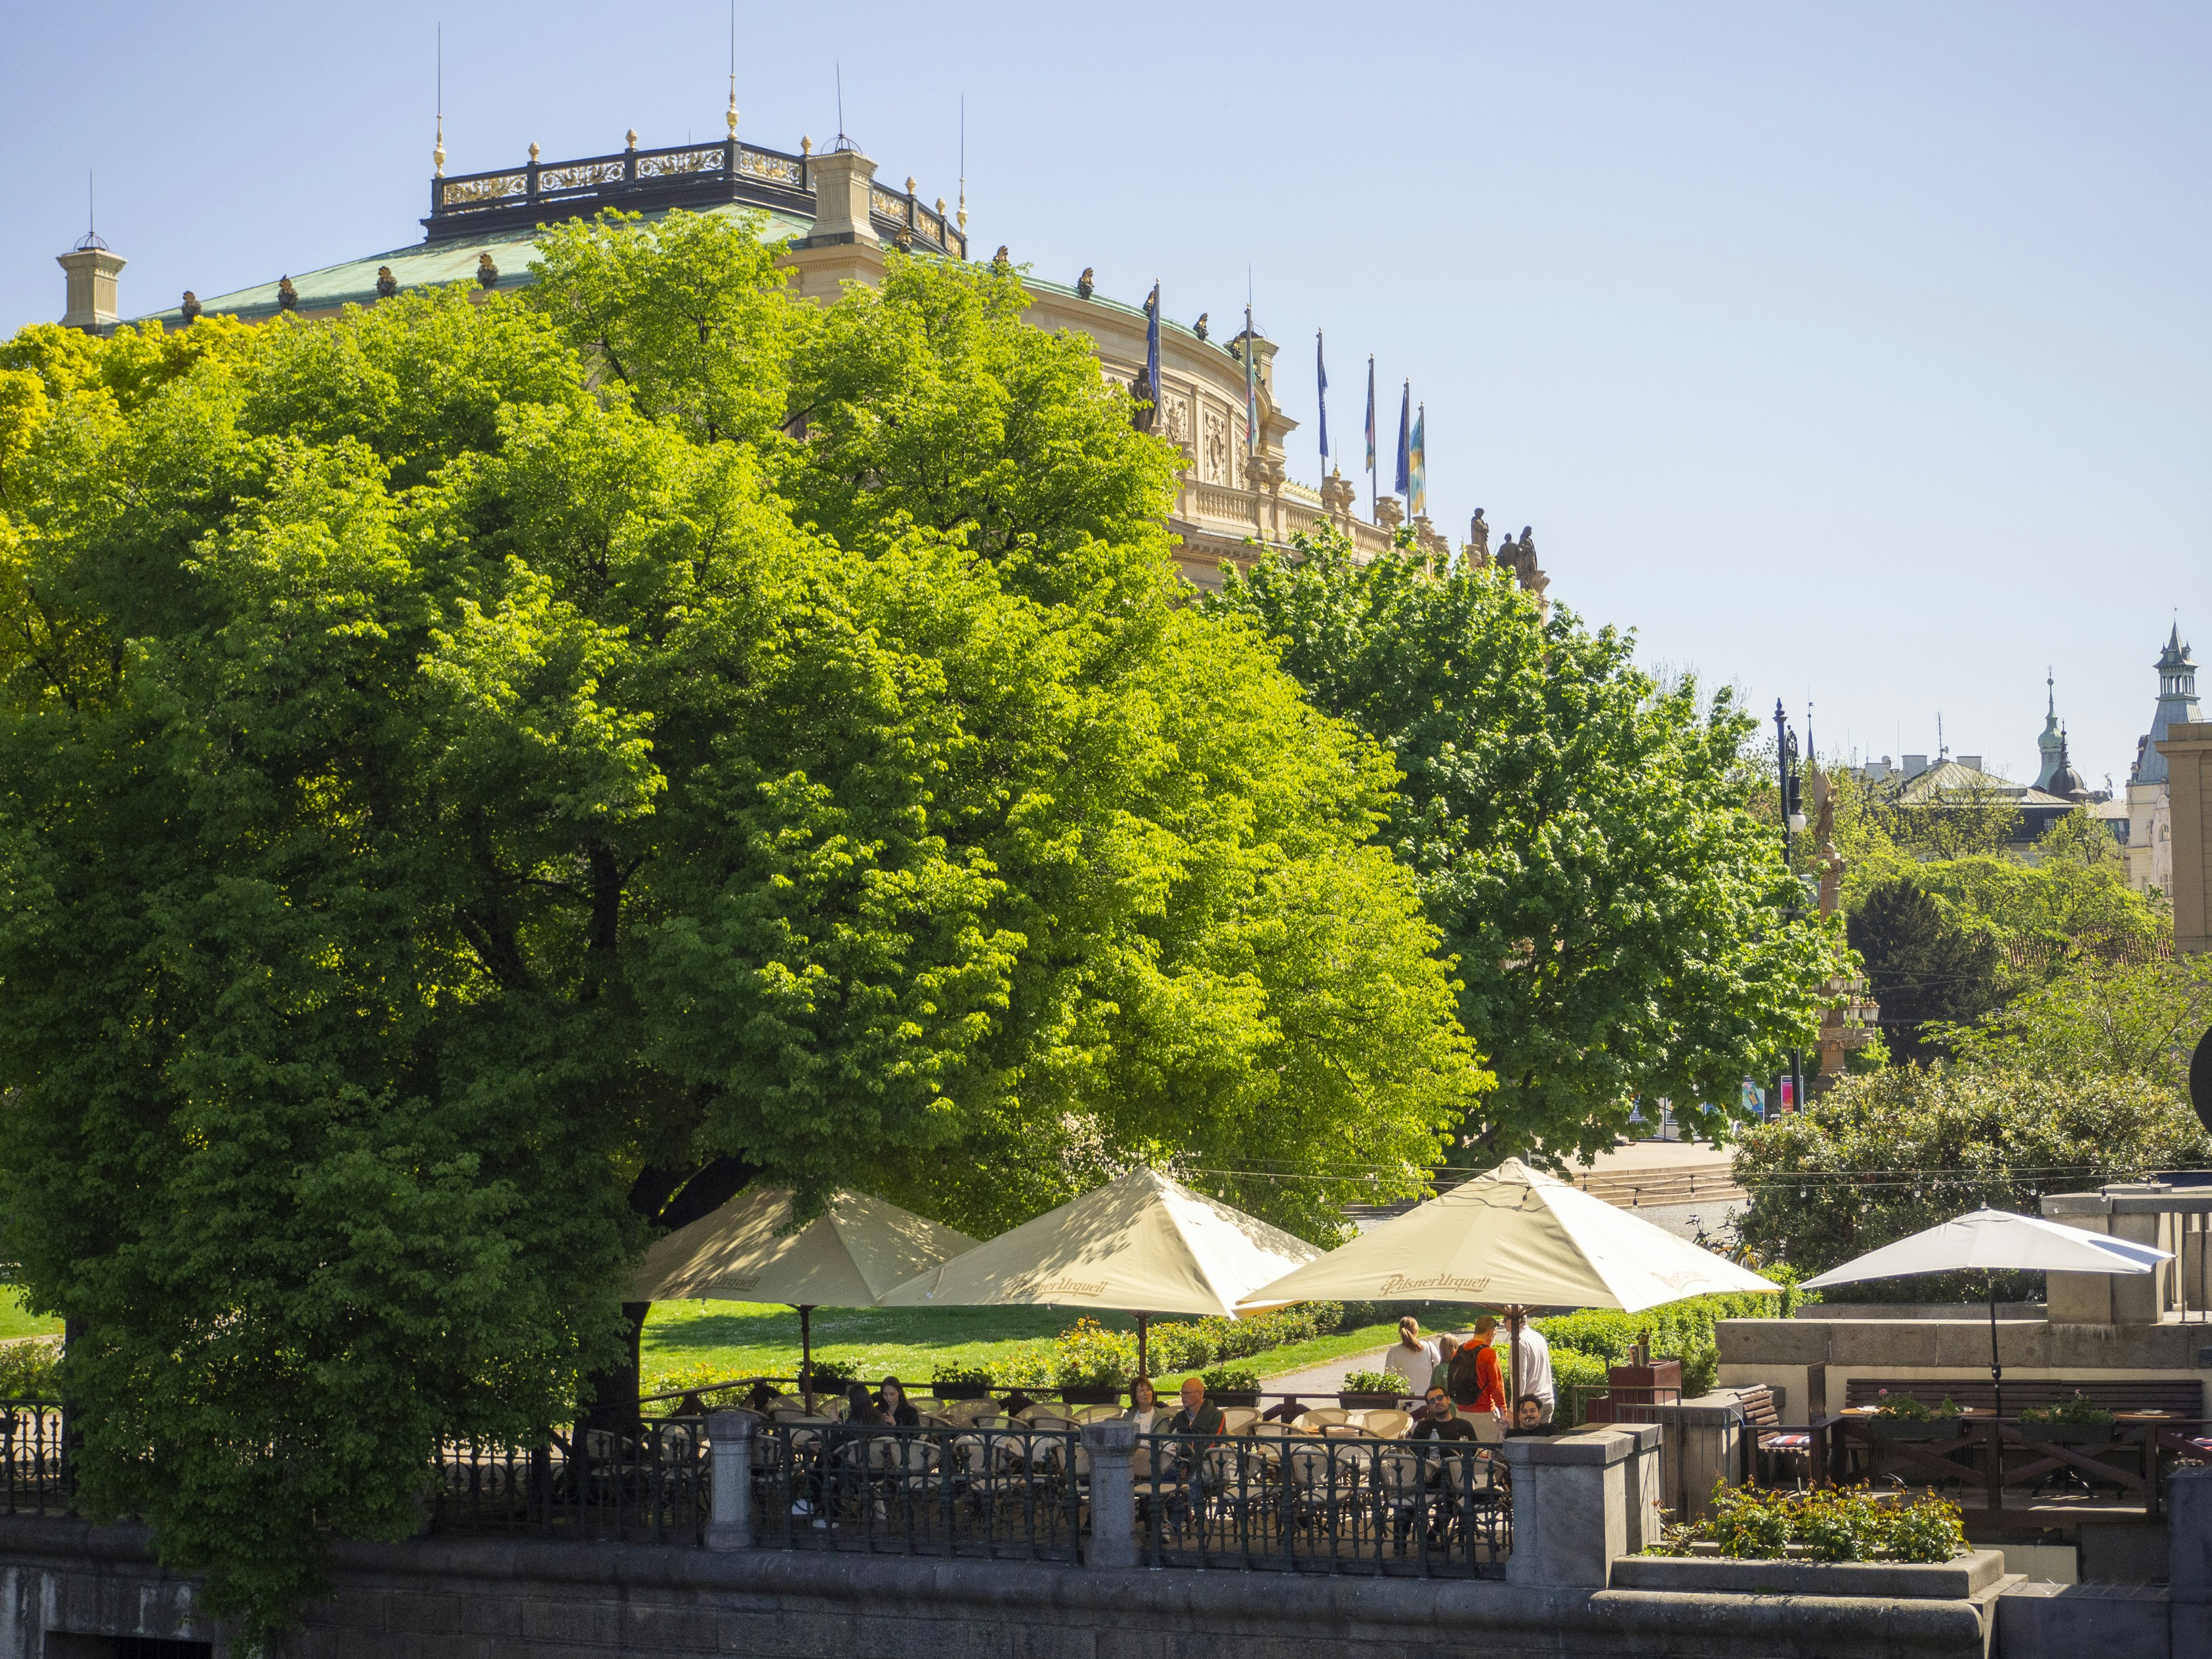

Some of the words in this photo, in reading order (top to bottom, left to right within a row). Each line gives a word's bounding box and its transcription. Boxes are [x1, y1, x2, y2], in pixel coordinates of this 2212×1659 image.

[1056, 1276, 1108, 1297] Urquell
[1378, 1274, 1440, 1297] Pilsner
[1437, 1272, 1491, 1293] Urquell
